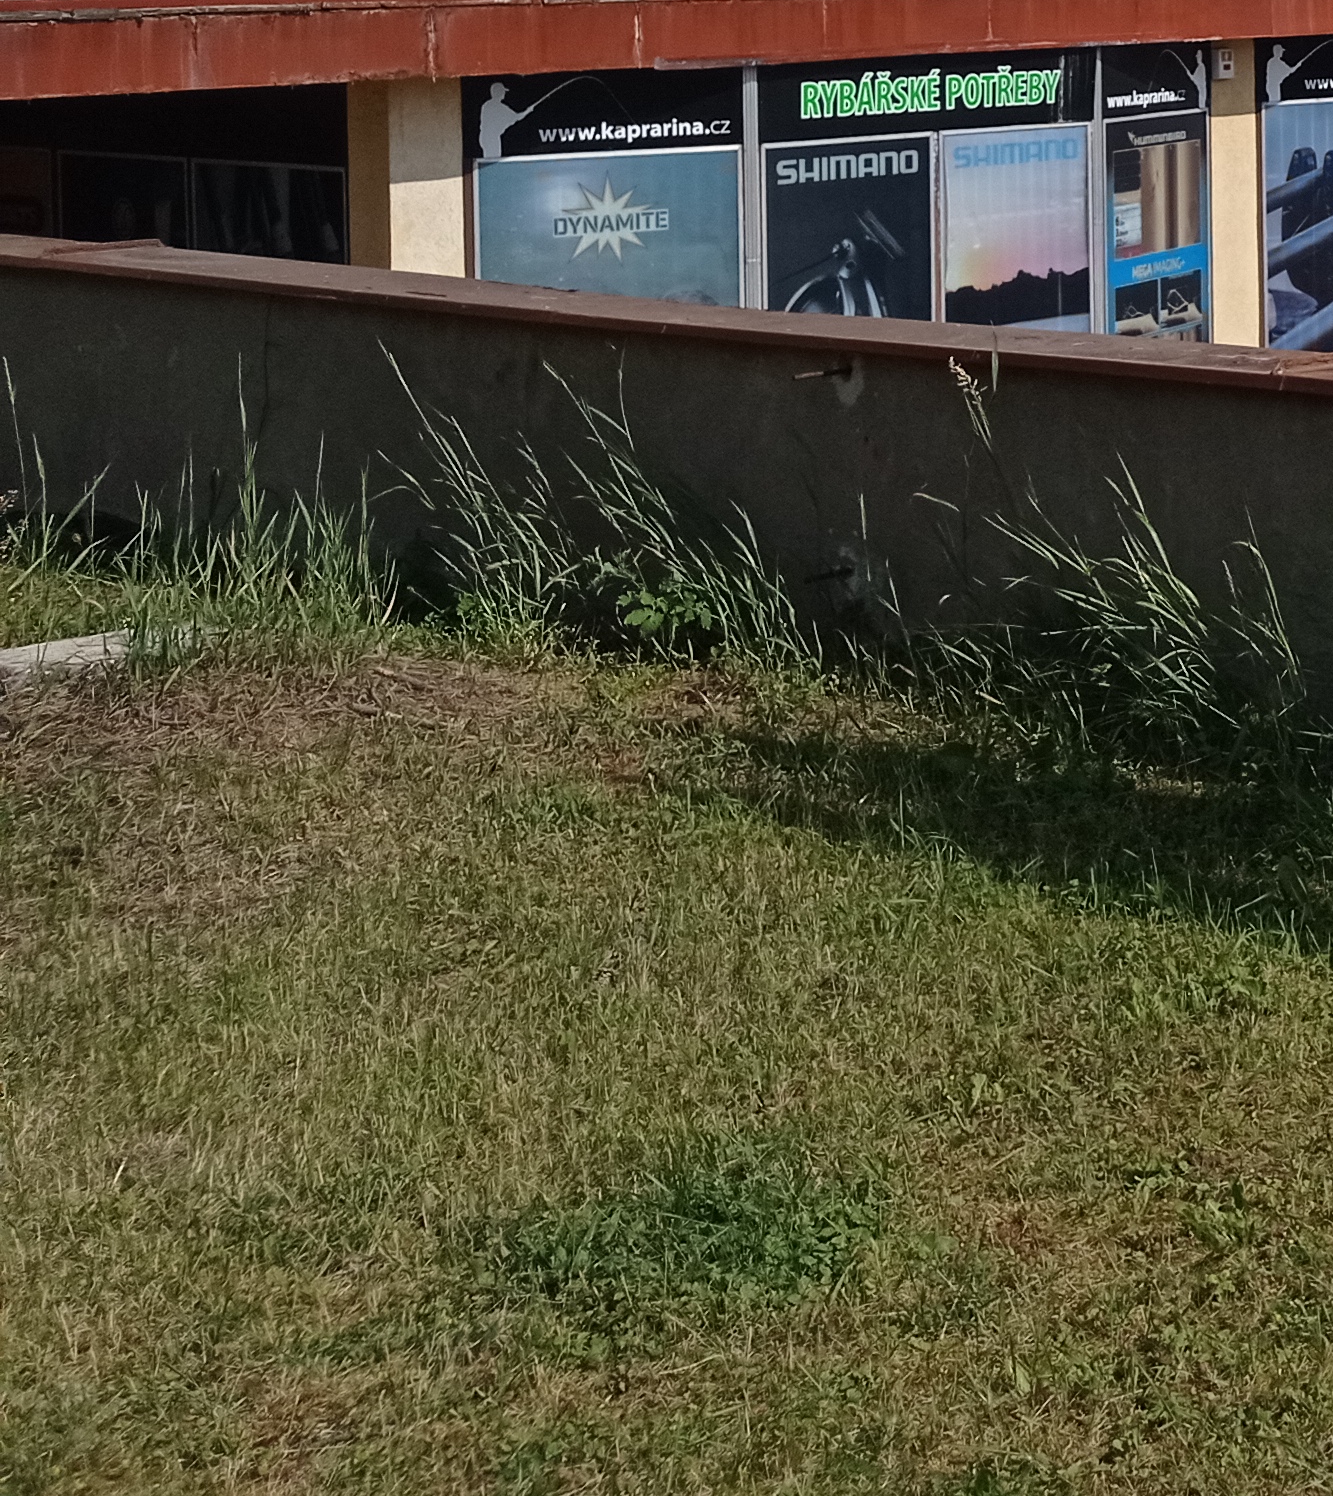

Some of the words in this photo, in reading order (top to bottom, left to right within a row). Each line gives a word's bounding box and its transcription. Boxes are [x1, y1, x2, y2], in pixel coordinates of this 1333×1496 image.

[801, 69, 940, 119] RYBÁŘSKÉ
[945, 64, 1061, 112] POTŘEBY
[1107, 89, 1186, 109] www.kaprarina.cz
[539, 118, 731, 145] www.kaprarina.cz
[776, 149, 919, 186] SHIMANO
[954, 138, 1078, 168] SHIMANO
[553, 208, 669, 238] DYNAMITE
